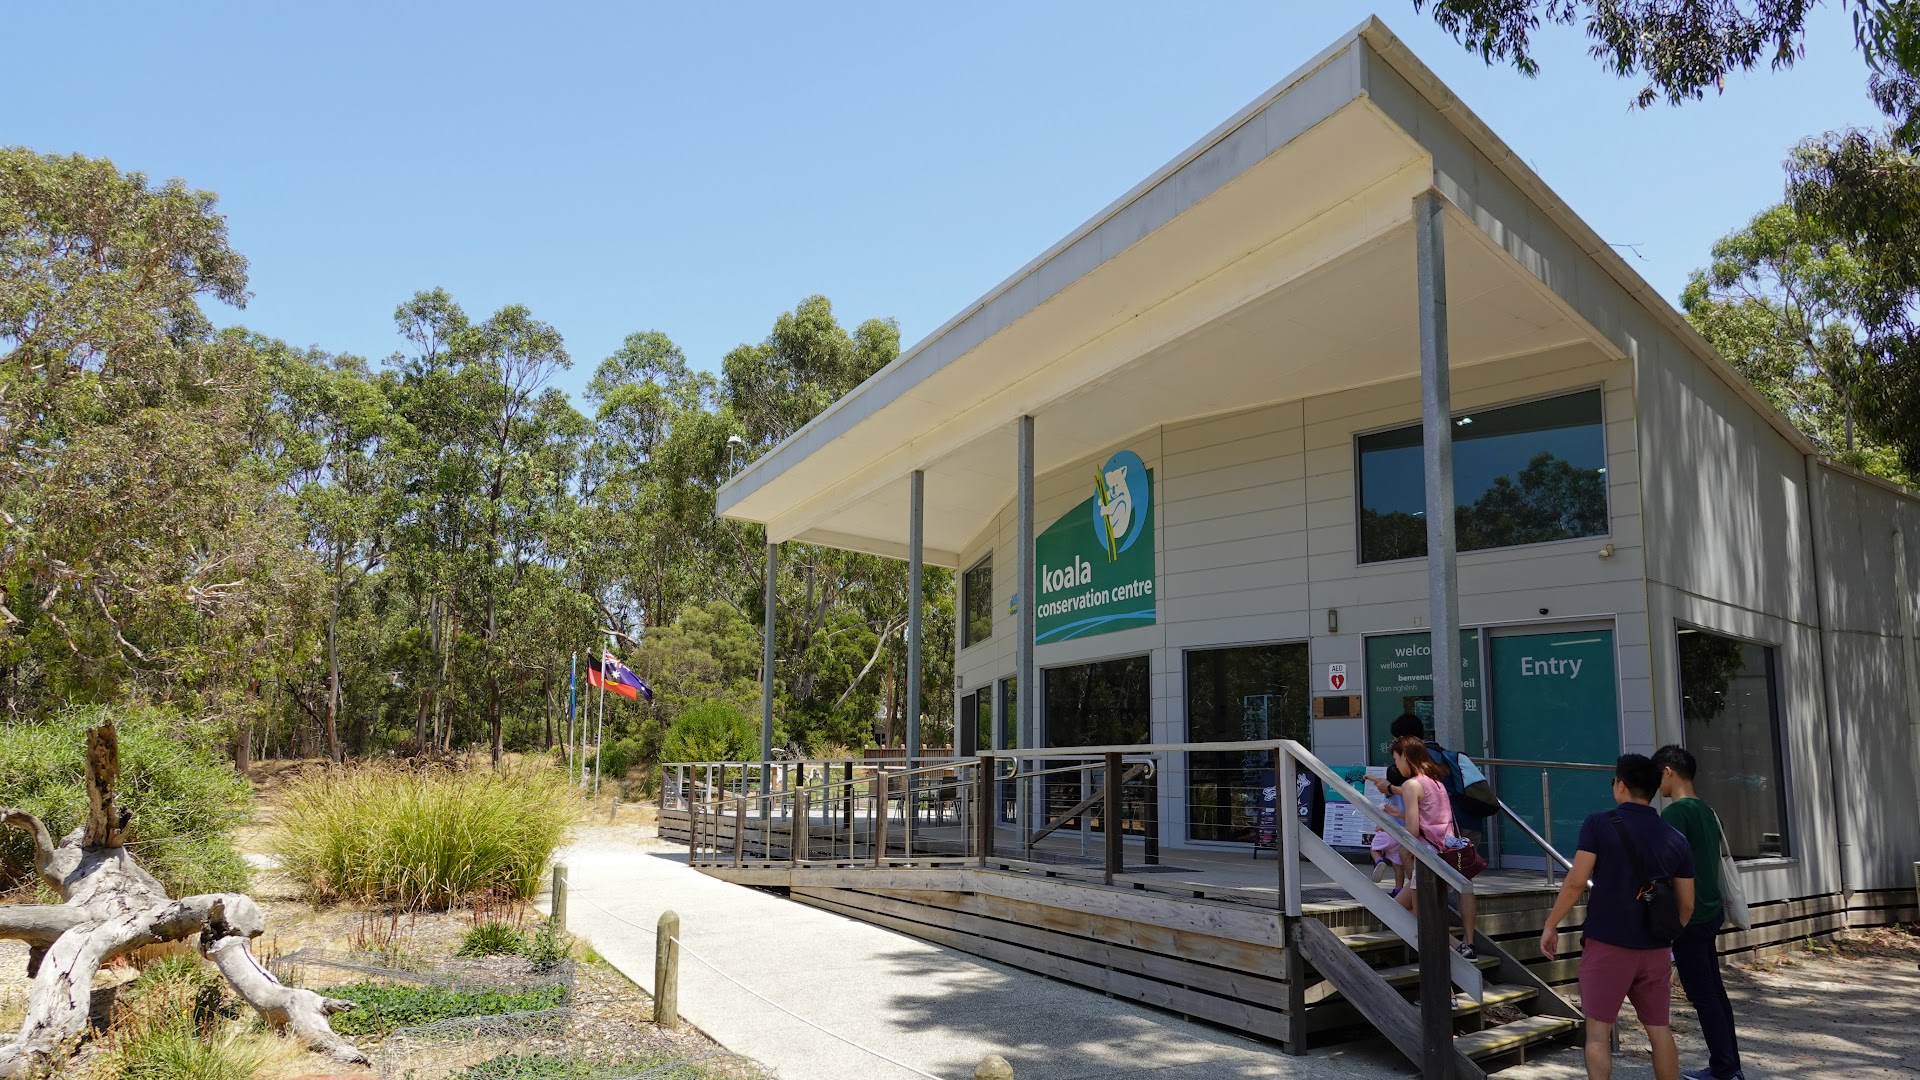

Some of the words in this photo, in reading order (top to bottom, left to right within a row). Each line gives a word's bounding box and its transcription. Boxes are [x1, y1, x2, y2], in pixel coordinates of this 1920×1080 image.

[1042, 555, 1091, 593] koala
[1038, 588, 1109, 618] conservation
[1112, 579, 1152, 601] centre
[1395, 644, 1431, 656] welco
[1380, 660, 1408, 670] welkom
[1521, 656, 1583, 680] Entry
[1398, 674, 1433, 682] benvenut
